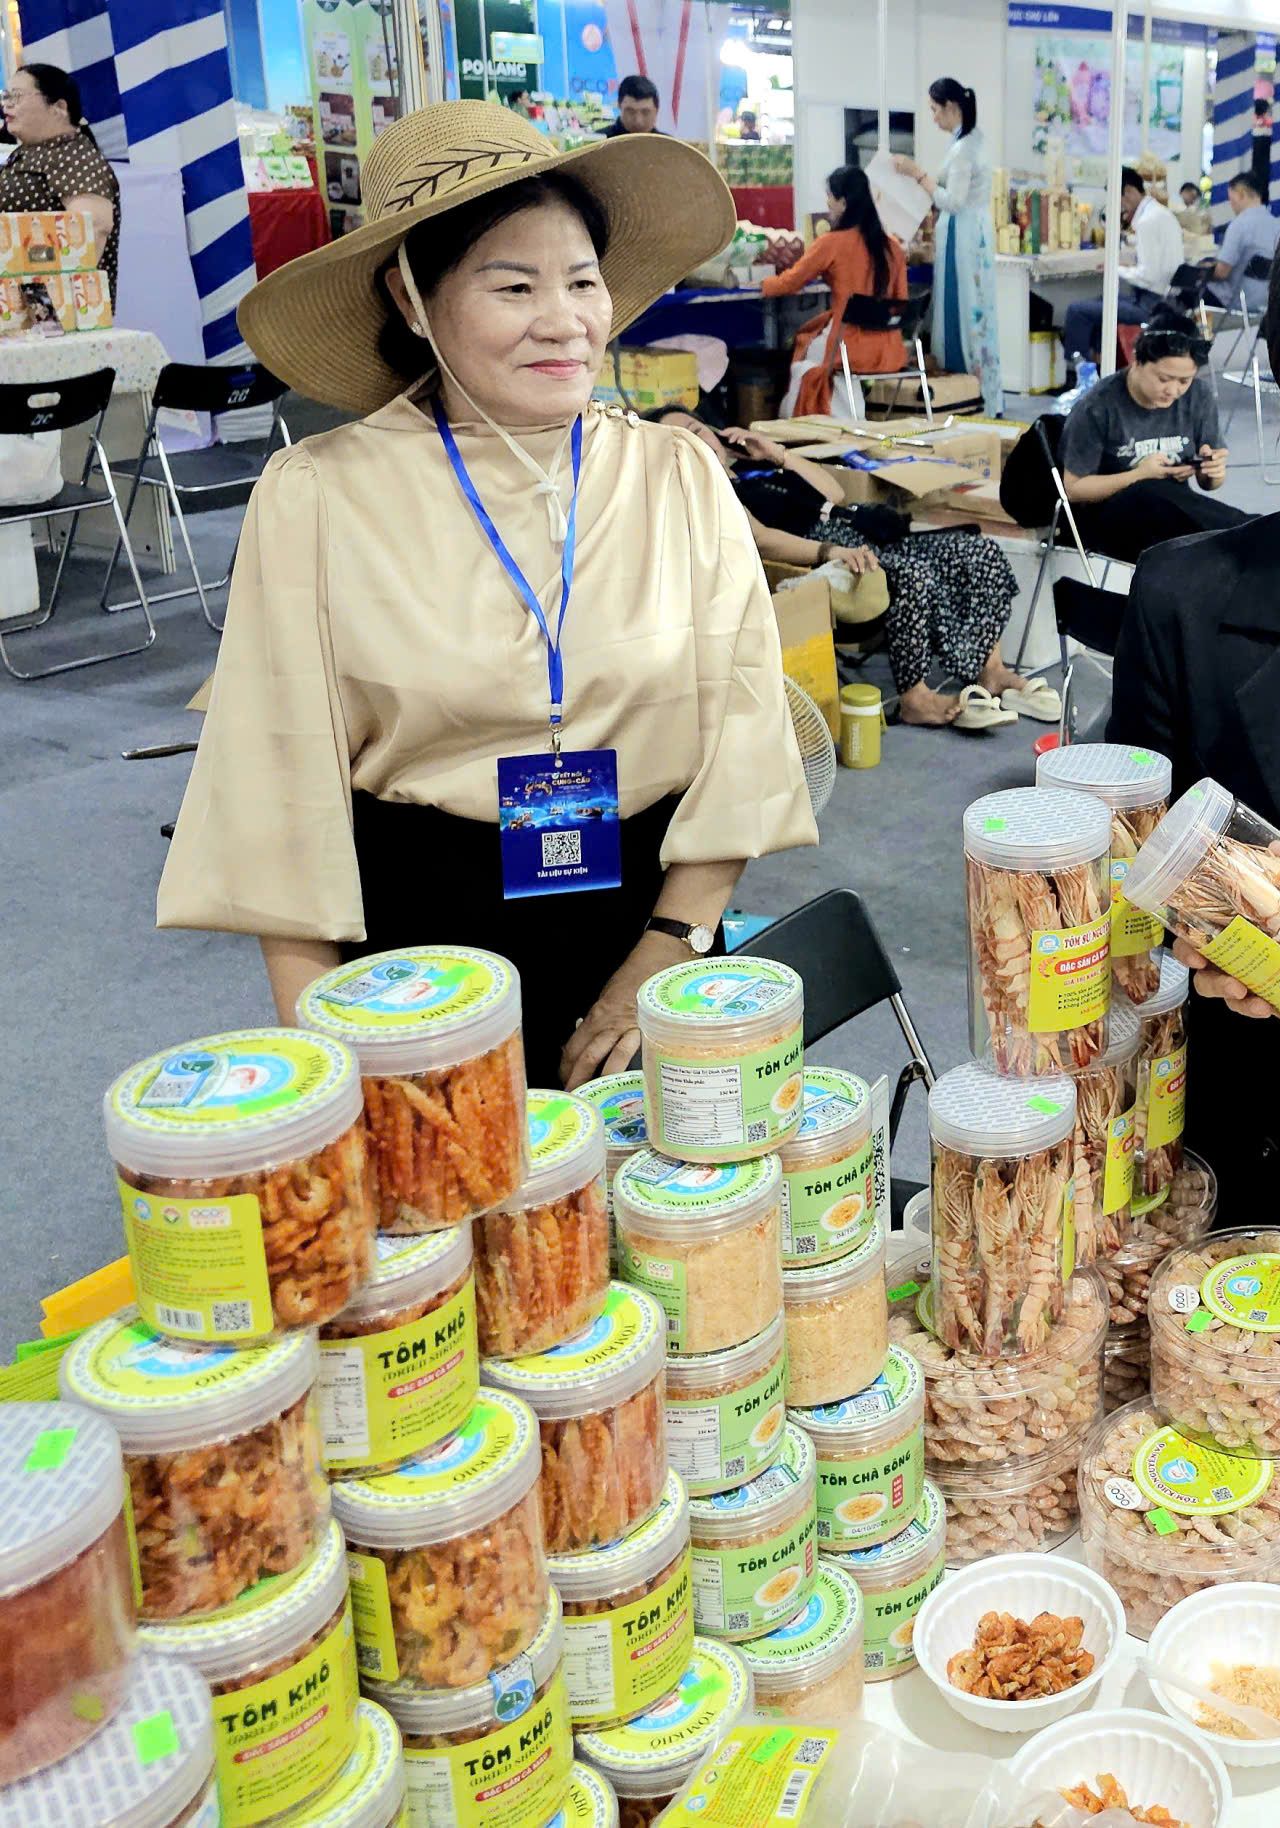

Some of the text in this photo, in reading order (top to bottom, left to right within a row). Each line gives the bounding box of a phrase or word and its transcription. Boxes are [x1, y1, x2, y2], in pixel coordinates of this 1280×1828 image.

[756, 1044, 800, 1079] TÔM CHÀ
[804, 1181, 833, 1197] TÔM
[836, 1166, 858, 1188] CHÀ
[377, 1306, 466, 1369] TÔM KHÔ
[735, 1397, 760, 1417] TÔM
[820, 1449, 912, 1487] TÔM CHÀ BÔNG
[738, 1557, 768, 1574] TÔM
[772, 1539, 796, 1563] CHÀ
[622, 1572, 688, 1636] TÔM KHÔ
[875, 1602, 902, 1617] TÔM
[906, 1587, 928, 1609] CHÀ
[221, 1658, 329, 1733] TÔM KHÔ
[464, 1708, 553, 1776] TÔM KHÔ
